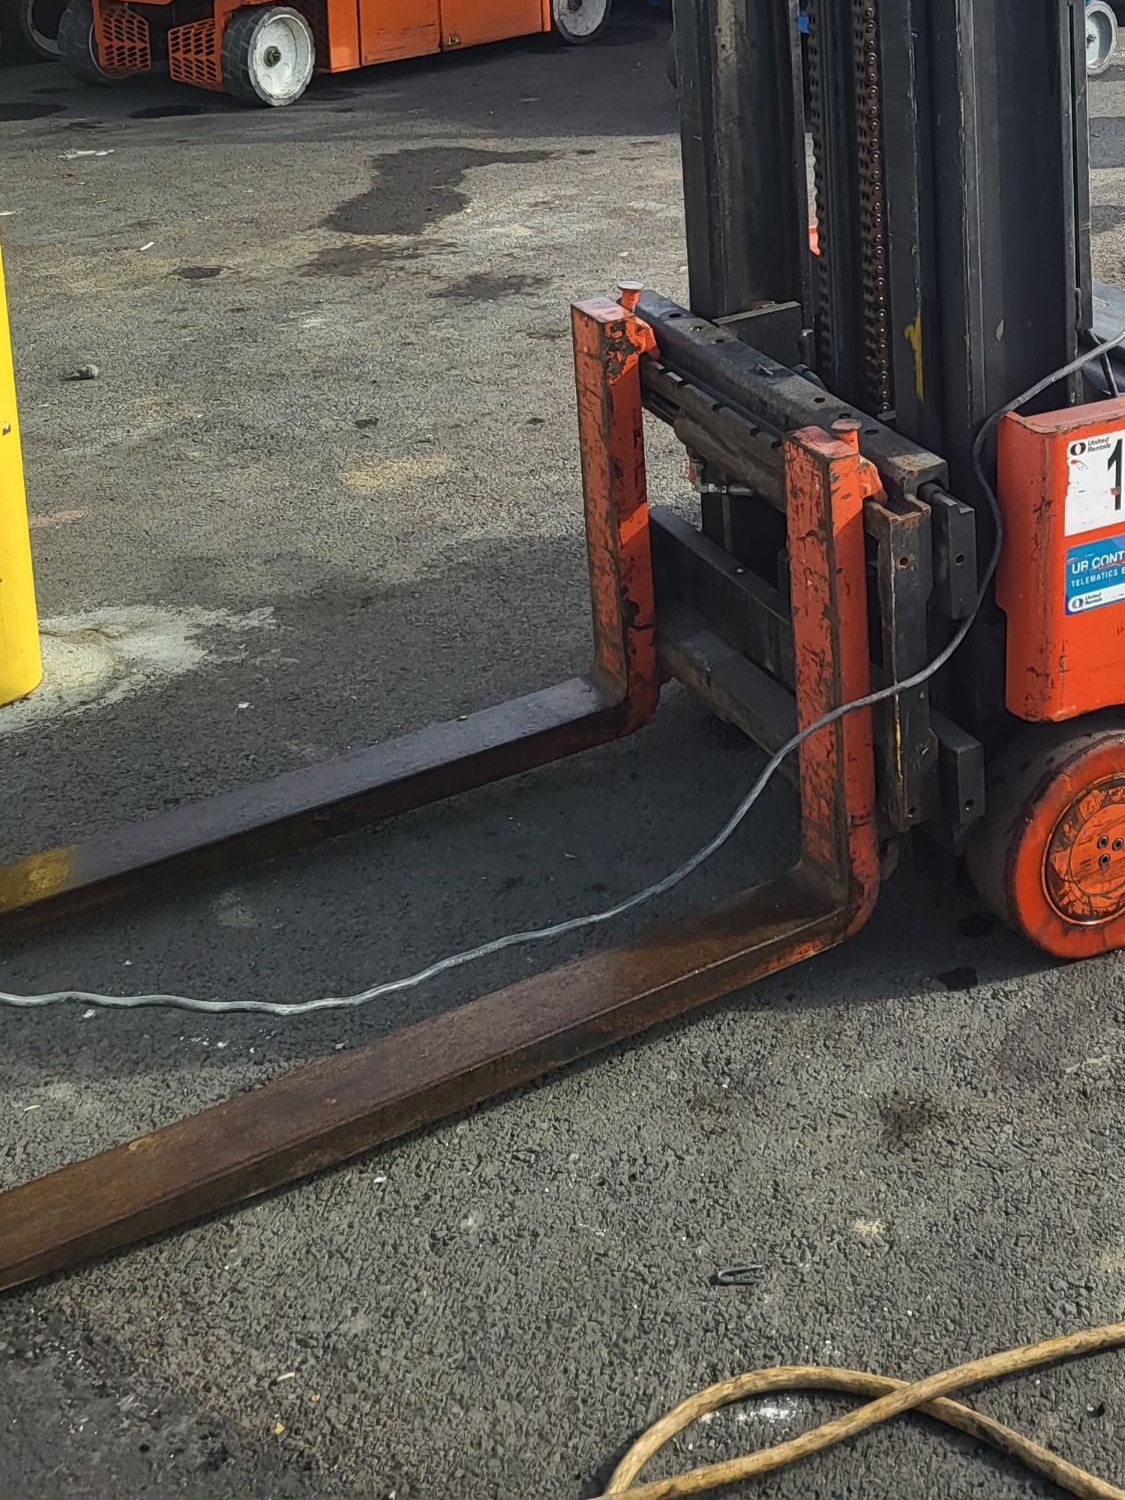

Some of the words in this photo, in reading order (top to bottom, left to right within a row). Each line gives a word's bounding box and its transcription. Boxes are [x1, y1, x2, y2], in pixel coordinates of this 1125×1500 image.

[1088, 436, 1110, 447] United
[1071, 560, 1089, 575] UR
[1071, 568, 1119, 588] TELEMATICS
